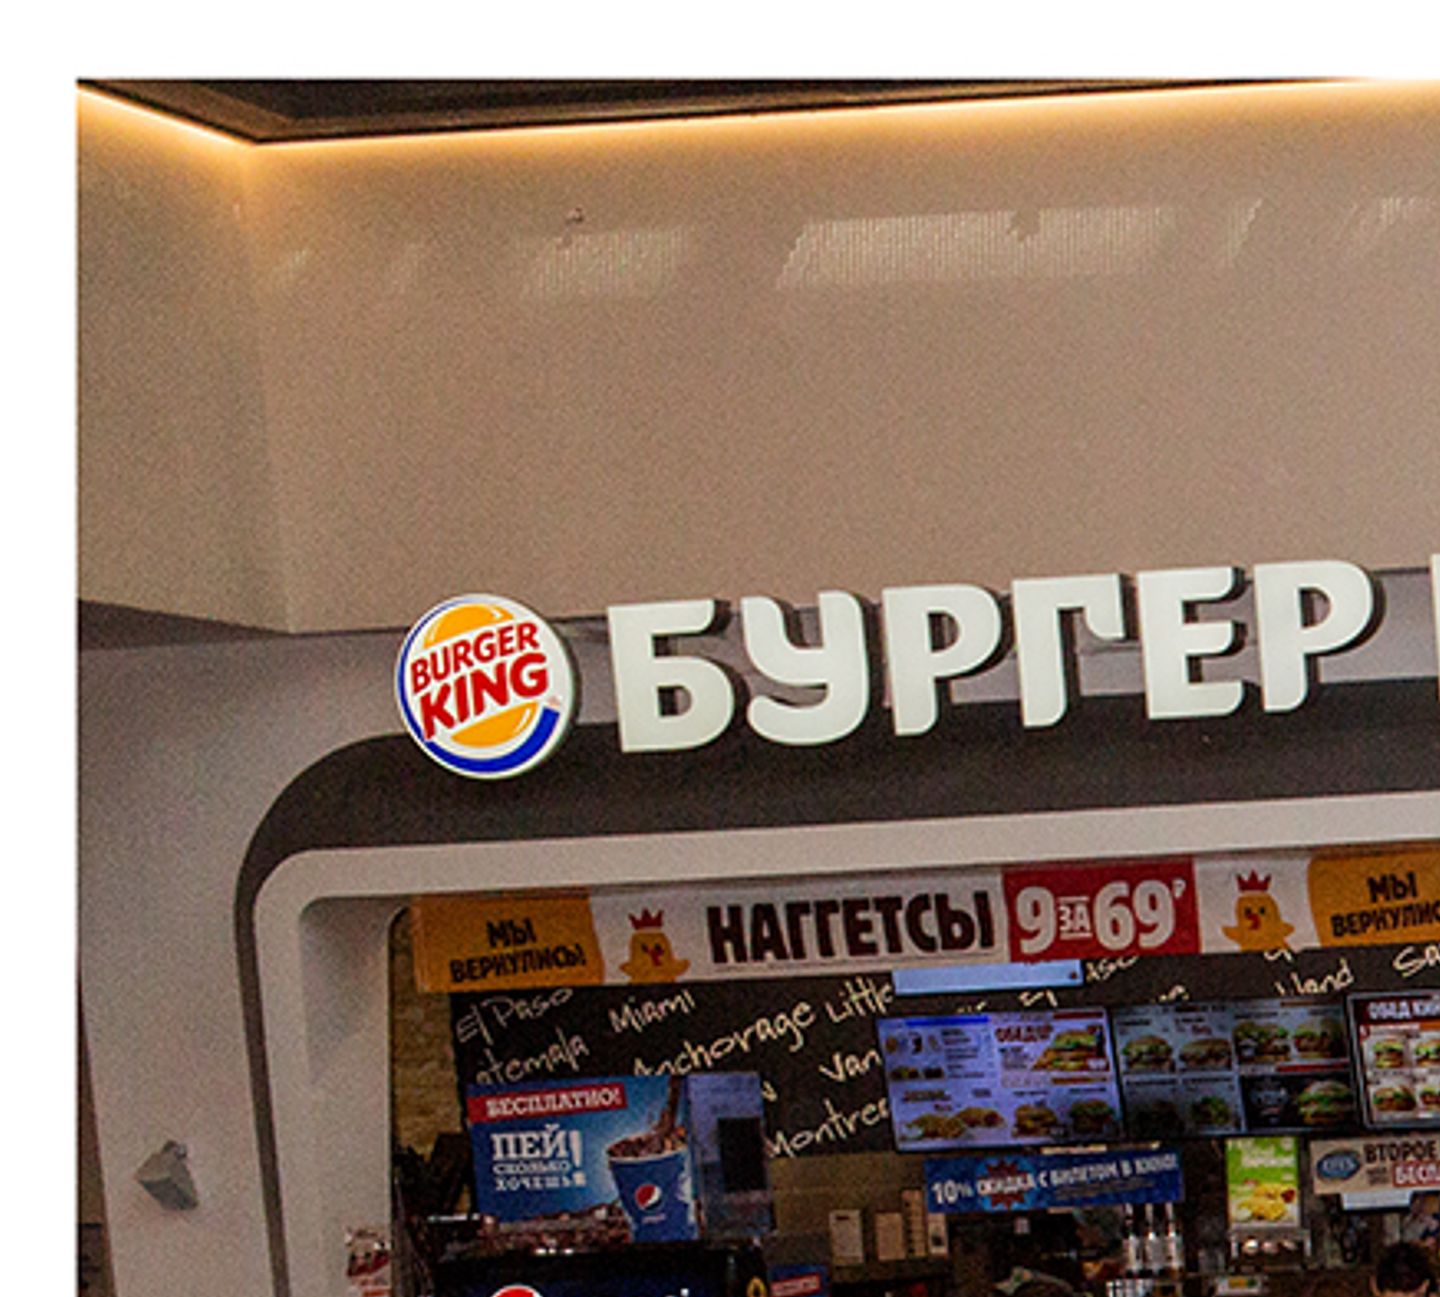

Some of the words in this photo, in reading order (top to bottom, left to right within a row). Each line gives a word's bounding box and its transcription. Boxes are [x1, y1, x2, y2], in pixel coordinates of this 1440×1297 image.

[411, 621, 540, 694] BURGER
[604, 558, 1378, 756] БУРГЕР
[420, 652, 549, 740] KING
[1367, 871, 1418, 903] МЫ
[486, 917, 537, 948] МЫ
[706, 890, 997, 964] НАГГЕТСЫ
[1017, 886, 1058, 950] 9
[449, 942, 587, 983] ВЕРНУЛИСЬ!
[456, 1002, 493, 1046] El
[480, 987, 573, 1028] Paso
[608, 989, 696, 1033] Miami
[476, 1026, 590, 1087] atemala
[485, 1087, 622, 1118] БЕСПЛАТНО!
[1363, 1141, 1437, 1163] ВТОРОЕ
